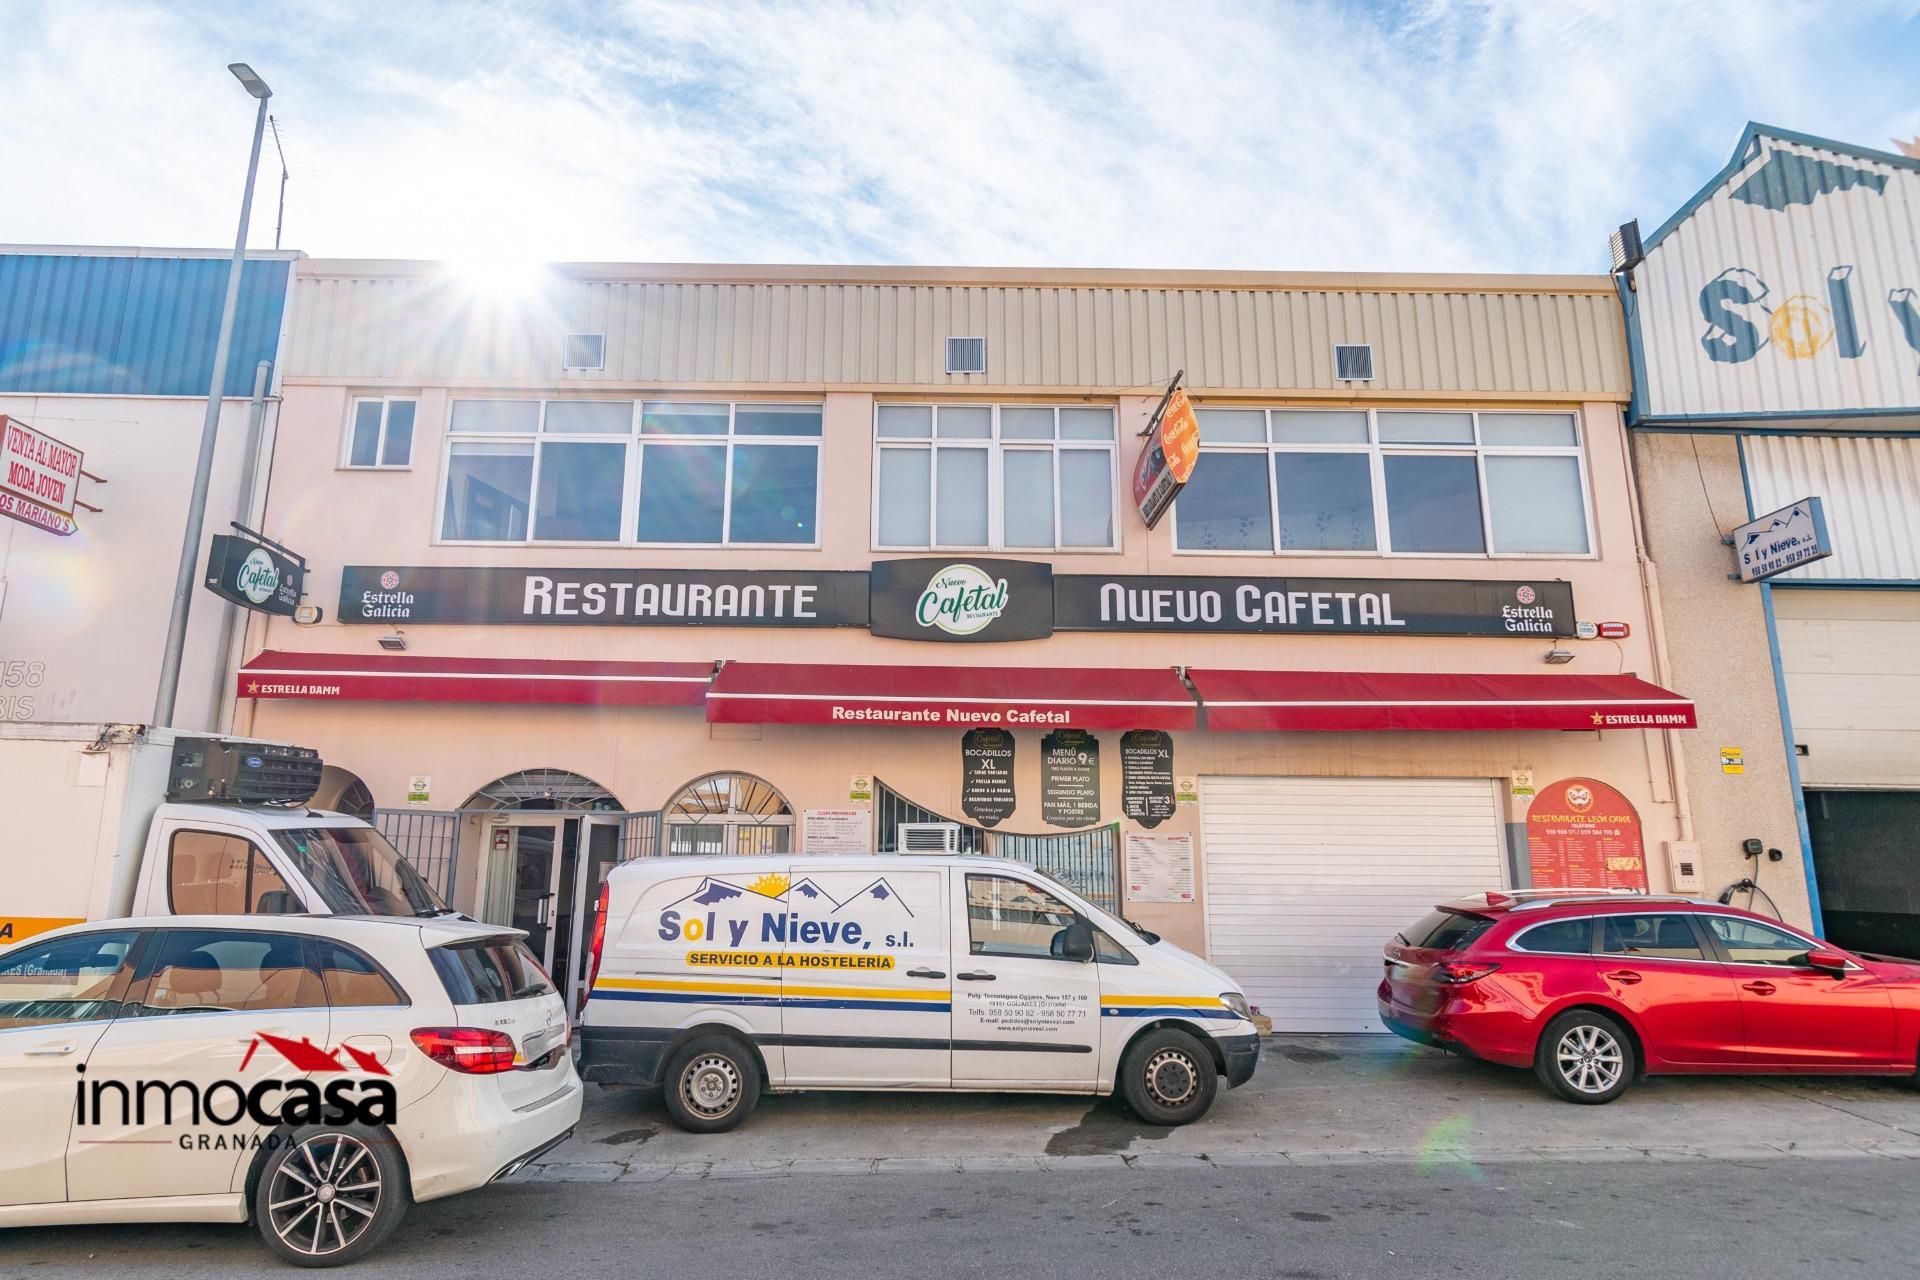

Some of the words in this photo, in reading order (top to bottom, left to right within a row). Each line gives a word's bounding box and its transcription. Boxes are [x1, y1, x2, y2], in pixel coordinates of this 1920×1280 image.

[8, 425, 36, 461] VENTA
[35, 440, 47, 466] AL
[47, 444, 77, 478] MAYOR
[8, 461, 36, 493] MODA
[36, 473, 66, 504] JOVEN
[16, 501, 70, 532] MARIANO'S
[239, 565, 279, 592] Cafetal
[936, 578, 967, 589] Nuevo
[361, 590, 414, 604] Estrella
[523, 576, 817, 618] RESTAURANTE
[918, 582, 1006, 625] Cafetal
[362, 604, 410, 617] Galicia
[1100, 583, 1221, 622] NUEVO
[1235, 584, 1405, 626] CAFETAL
[966, 611, 999, 619] RESTAURANTE
[1502, 605, 1553, 619] Estrella
[1505, 618, 1552, 632] Galicia
[261, 684, 307, 694] ESTRELLA
[309, 685, 340, 695] DAMM
[832, 706, 941, 722] Restaurante
[946, 708, 1001, 723] Nuevo
[1006, 709, 1070, 724] Cafetal
[1606, 715, 1654, 724] ESTRELLA
[1655, 715, 1687, 724] DAMM
[965, 749, 1012, 757] BOCADILLOS
[1052, 747, 1076, 756] MENÚ
[1158, 749, 1169, 758] XL
[981, 759, 996, 769] XL
[1047, 757, 1077, 765] DIARIO
[658, 910, 716, 942] Sol
[728, 919, 749, 948] y
[761, 912, 872, 950] Nieve,
[885, 931, 914, 948] s.l.
[690, 953, 759, 966] SERVICIO
[762, 955, 773, 966] A
[777, 955, 795, 967] LA
[799, 954, 891, 969] HOSTELERÍA
